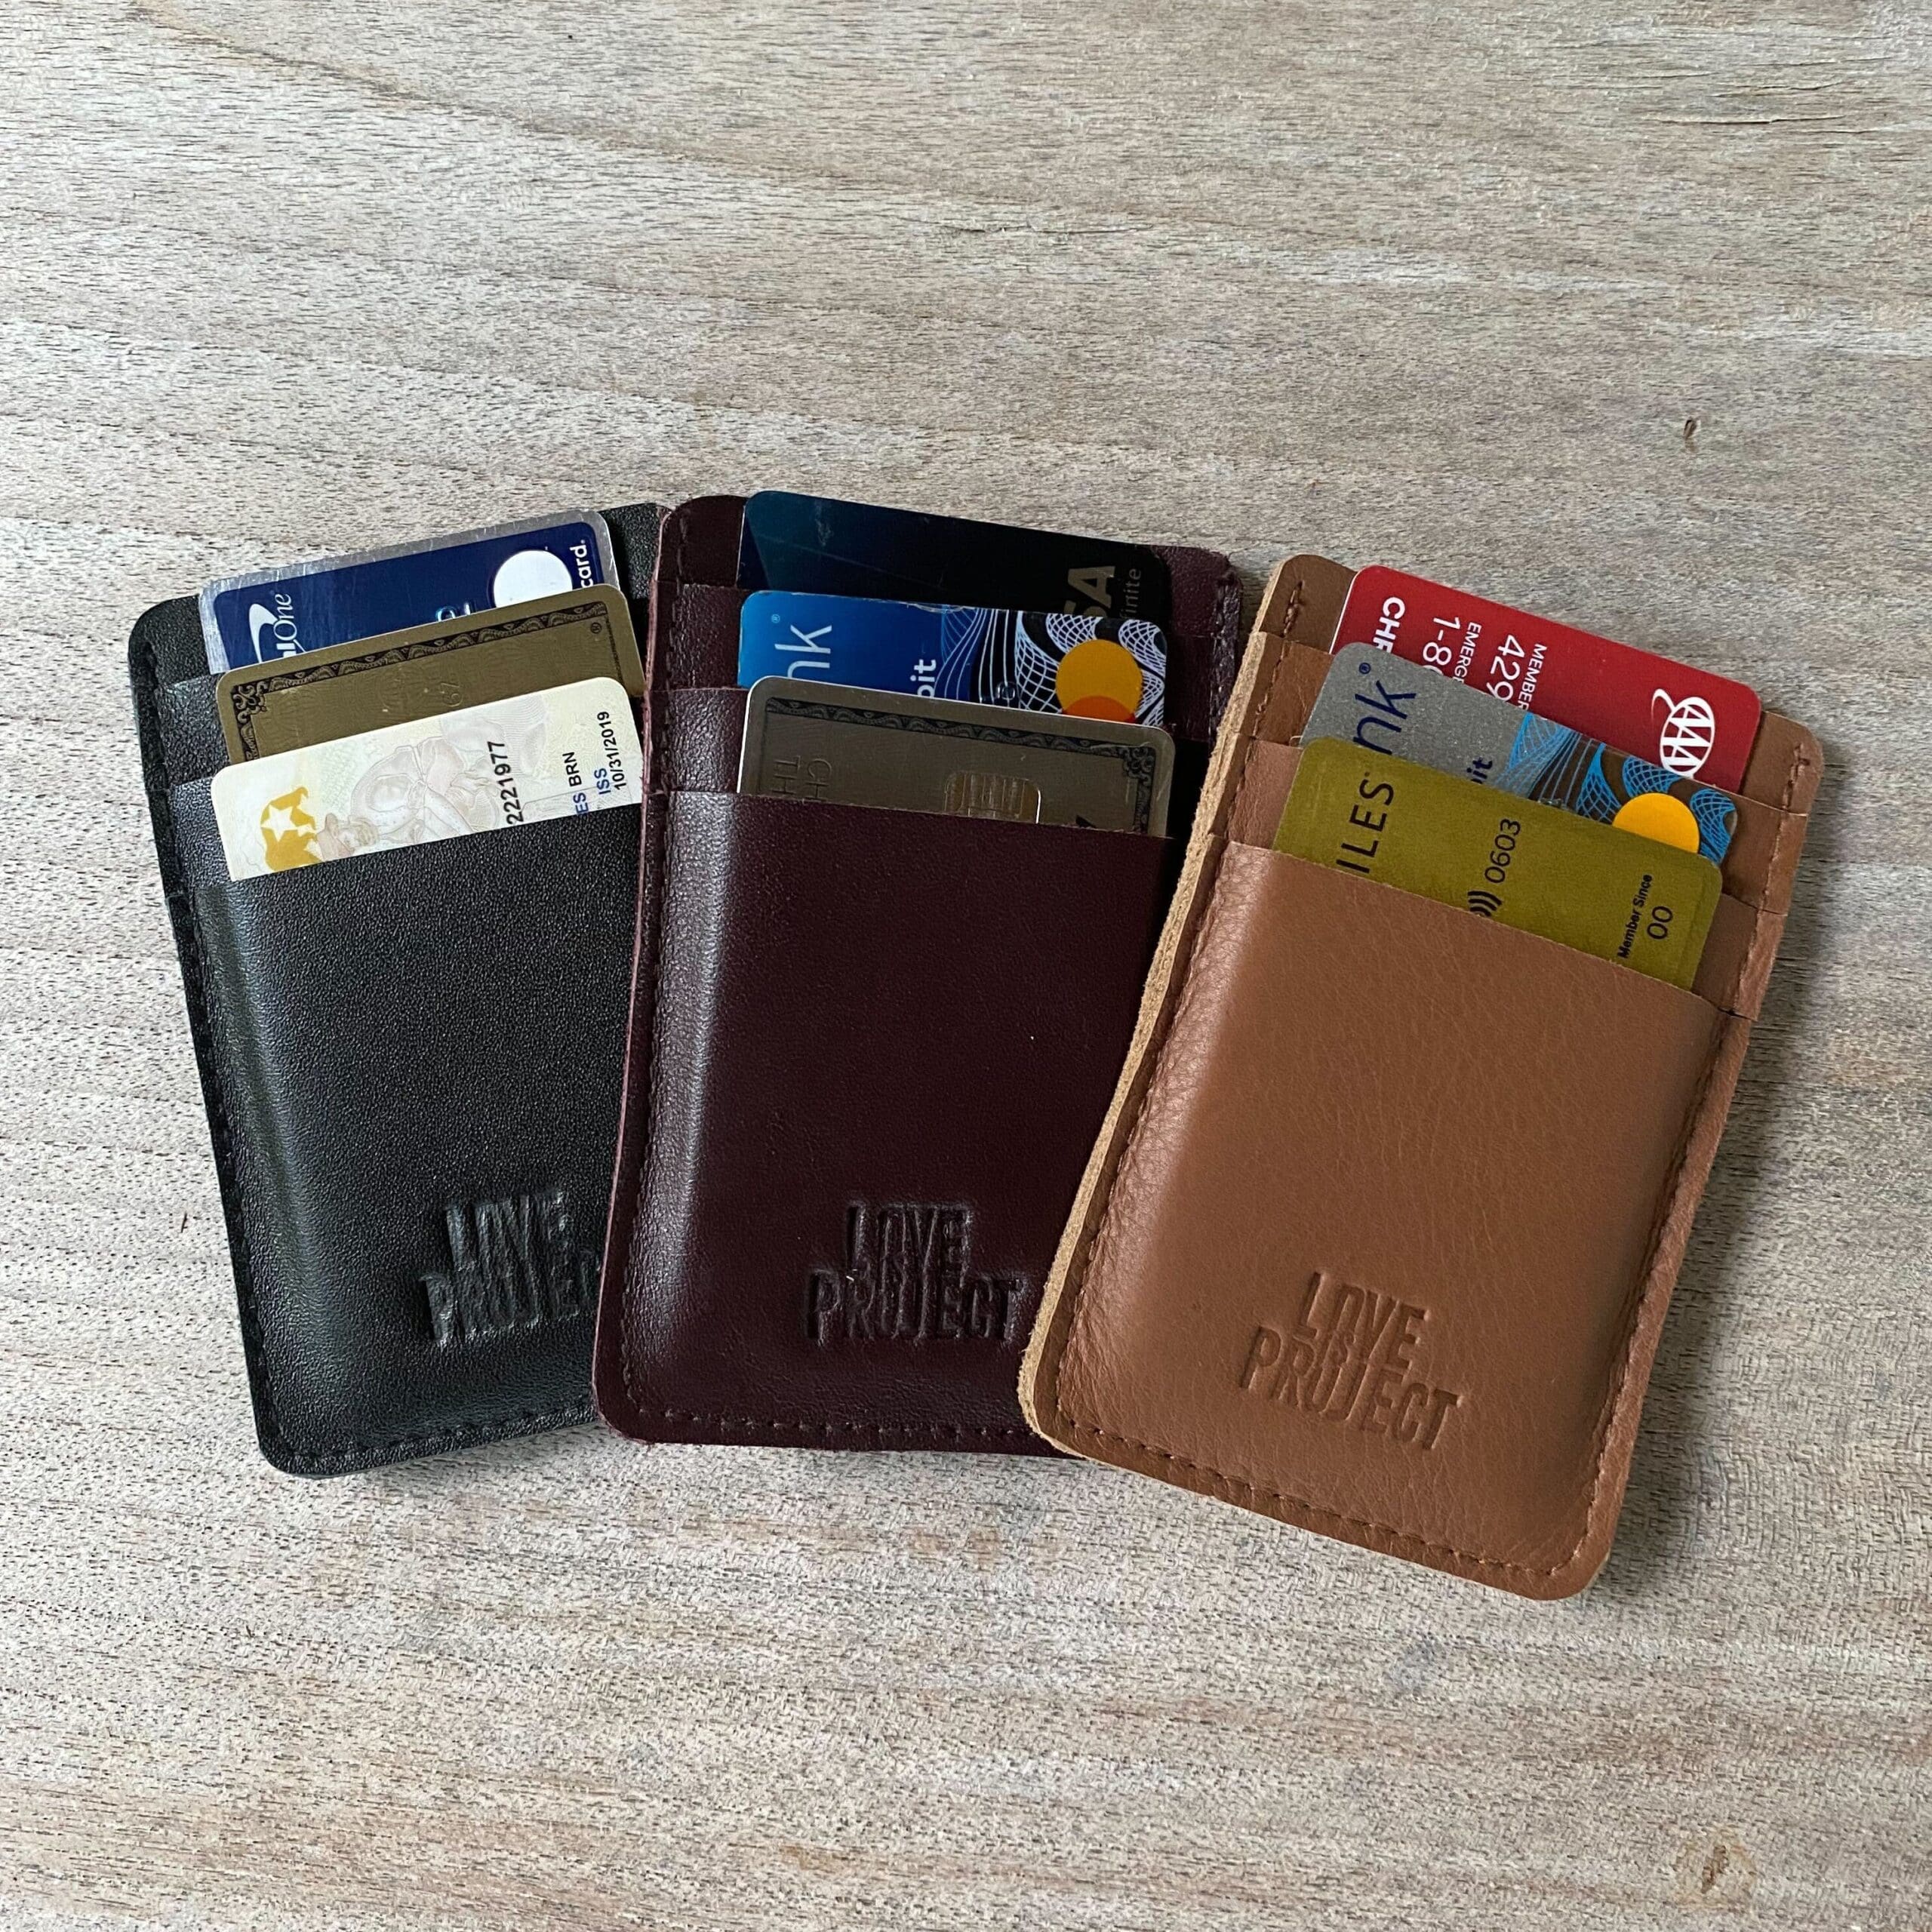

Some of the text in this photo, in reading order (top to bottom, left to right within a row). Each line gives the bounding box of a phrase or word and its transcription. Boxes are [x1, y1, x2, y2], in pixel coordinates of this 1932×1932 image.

[1487, 635, 1525, 703] 429
[597, 711, 626, 790] 10/31/2019
[1353, 680, 1417, 755] nk
[488, 741, 524, 824] 2221977
[562, 752, 582, 786] BRN
[594, 768, 611, 795] ISS
[1467, 757, 1493, 784] it
[1484, 819, 1521, 884] 0603
[1617, 874, 1653, 958] Member Since
[1647, 906, 1673, 940] 00
[845, 1204, 972, 1277] LOVE
[1298, 1272, 1428, 1370] LOVE
[1240, 1326, 1462, 1450] PROJECT
